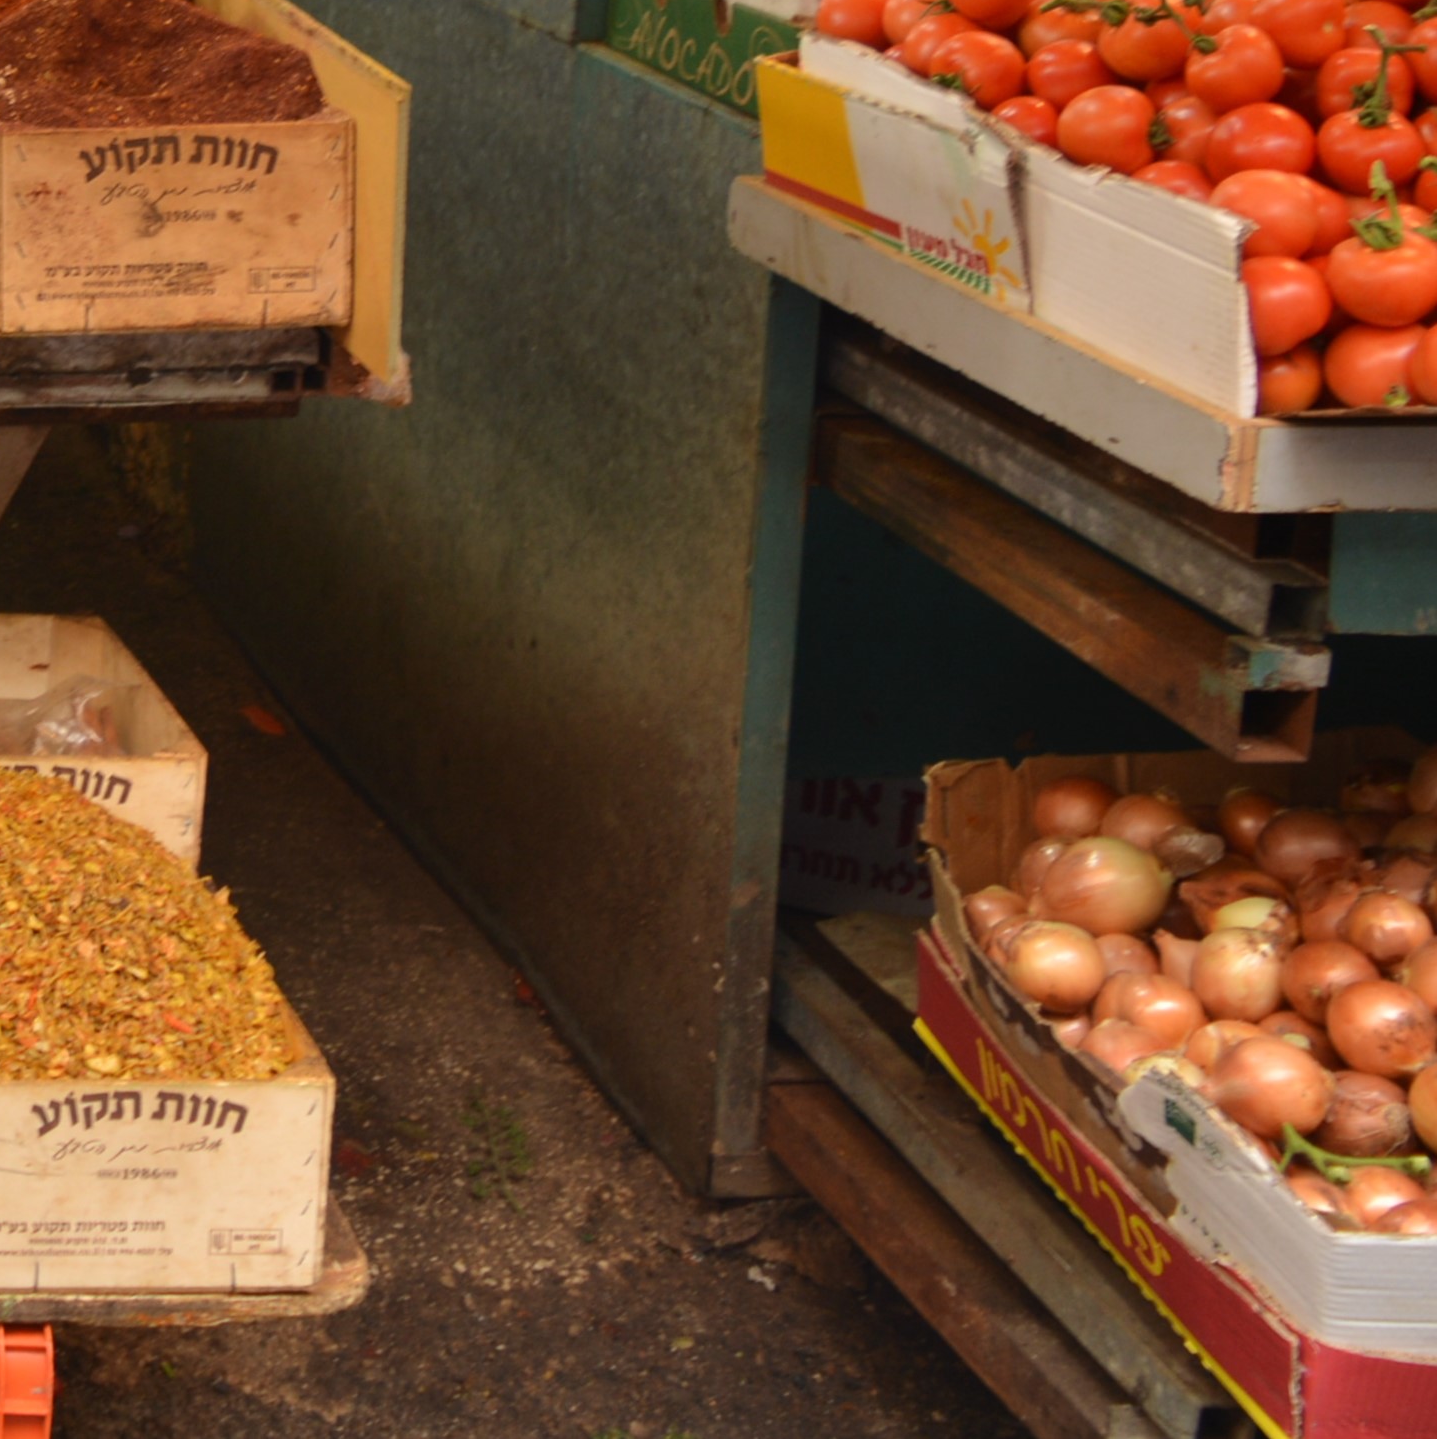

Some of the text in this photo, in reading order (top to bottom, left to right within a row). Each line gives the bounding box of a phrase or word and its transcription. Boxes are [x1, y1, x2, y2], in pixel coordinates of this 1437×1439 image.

[627, 9, 756, 106] AVOCADO
[190, 135, 280, 175] חוות
[152, 1088, 249, 1134] חוות
[122, 1167, 163, 1181] 1986
